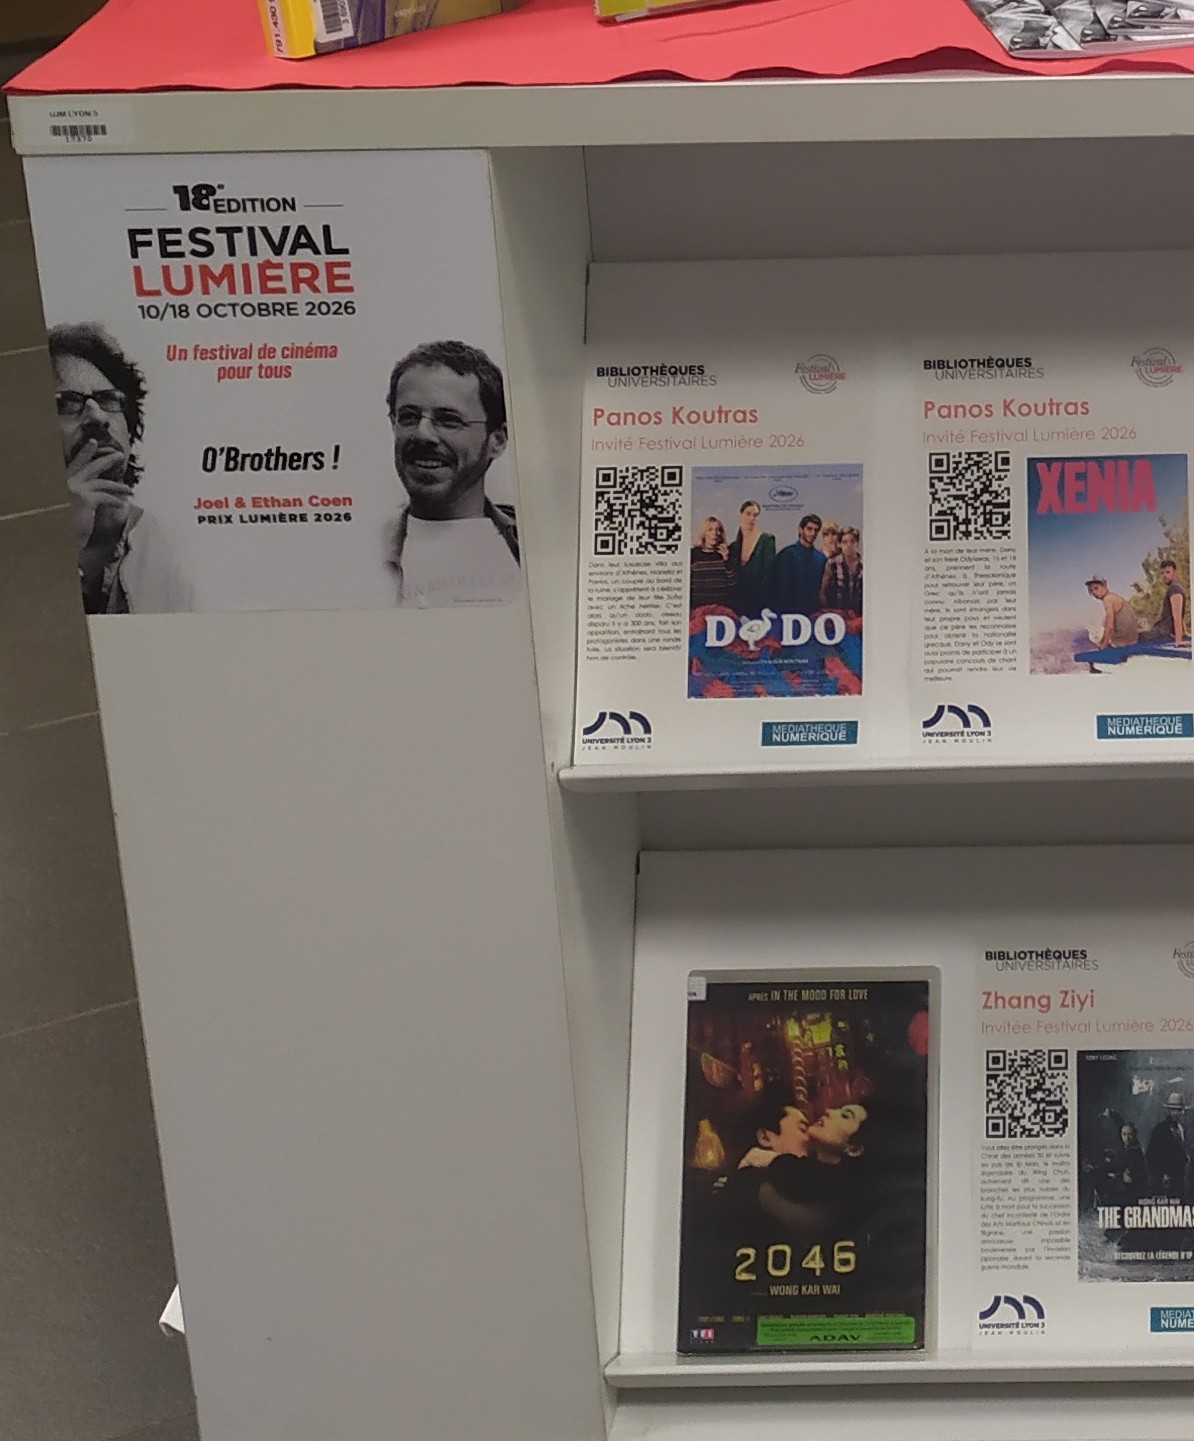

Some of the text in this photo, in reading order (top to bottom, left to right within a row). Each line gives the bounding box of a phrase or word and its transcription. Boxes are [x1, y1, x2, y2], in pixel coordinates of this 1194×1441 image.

[213, 197, 297, 214] EDITION
[127, 224, 350, 260] FESTIVAL
[132, 258, 355, 298] LUMIÈRE
[138, 300, 357, 322] 10/18 OCTOBRE 2026
[166, 341, 338, 362] Un festival de cinéma
[217, 363, 293, 383] pour tous
[597, 362, 705, 377] BIBLIOTHÈQUES
[593, 405, 759, 427] Panos Koutras
[923, 397, 1090, 420] Panos Koutras
[591, 434, 805, 451] Invité Festival Lumière 2026
[1036, 460, 1157, 515] XENIA
[193, 494, 353, 510] Joel Ethan Coen
[197, 511, 353, 525] PRIX LUMIÈRE 2026
[985, 948, 1088, 962] BIBLIOTHÈQUES
[770, 989, 869, 1001] IN THE MOOD FOR LOVE
[981, 989, 1096, 1013] Zhang Ziyi
[981, 1019, 1194, 1035] Invitée Festival Lumière 2026
[1097, 1206, 1122, 1229] THE
[734, 1239, 858, 1282] 2046
[769, 1284, 841, 1296] WONG KAR WAI
[809, 1334, 863, 1342] ADAV
